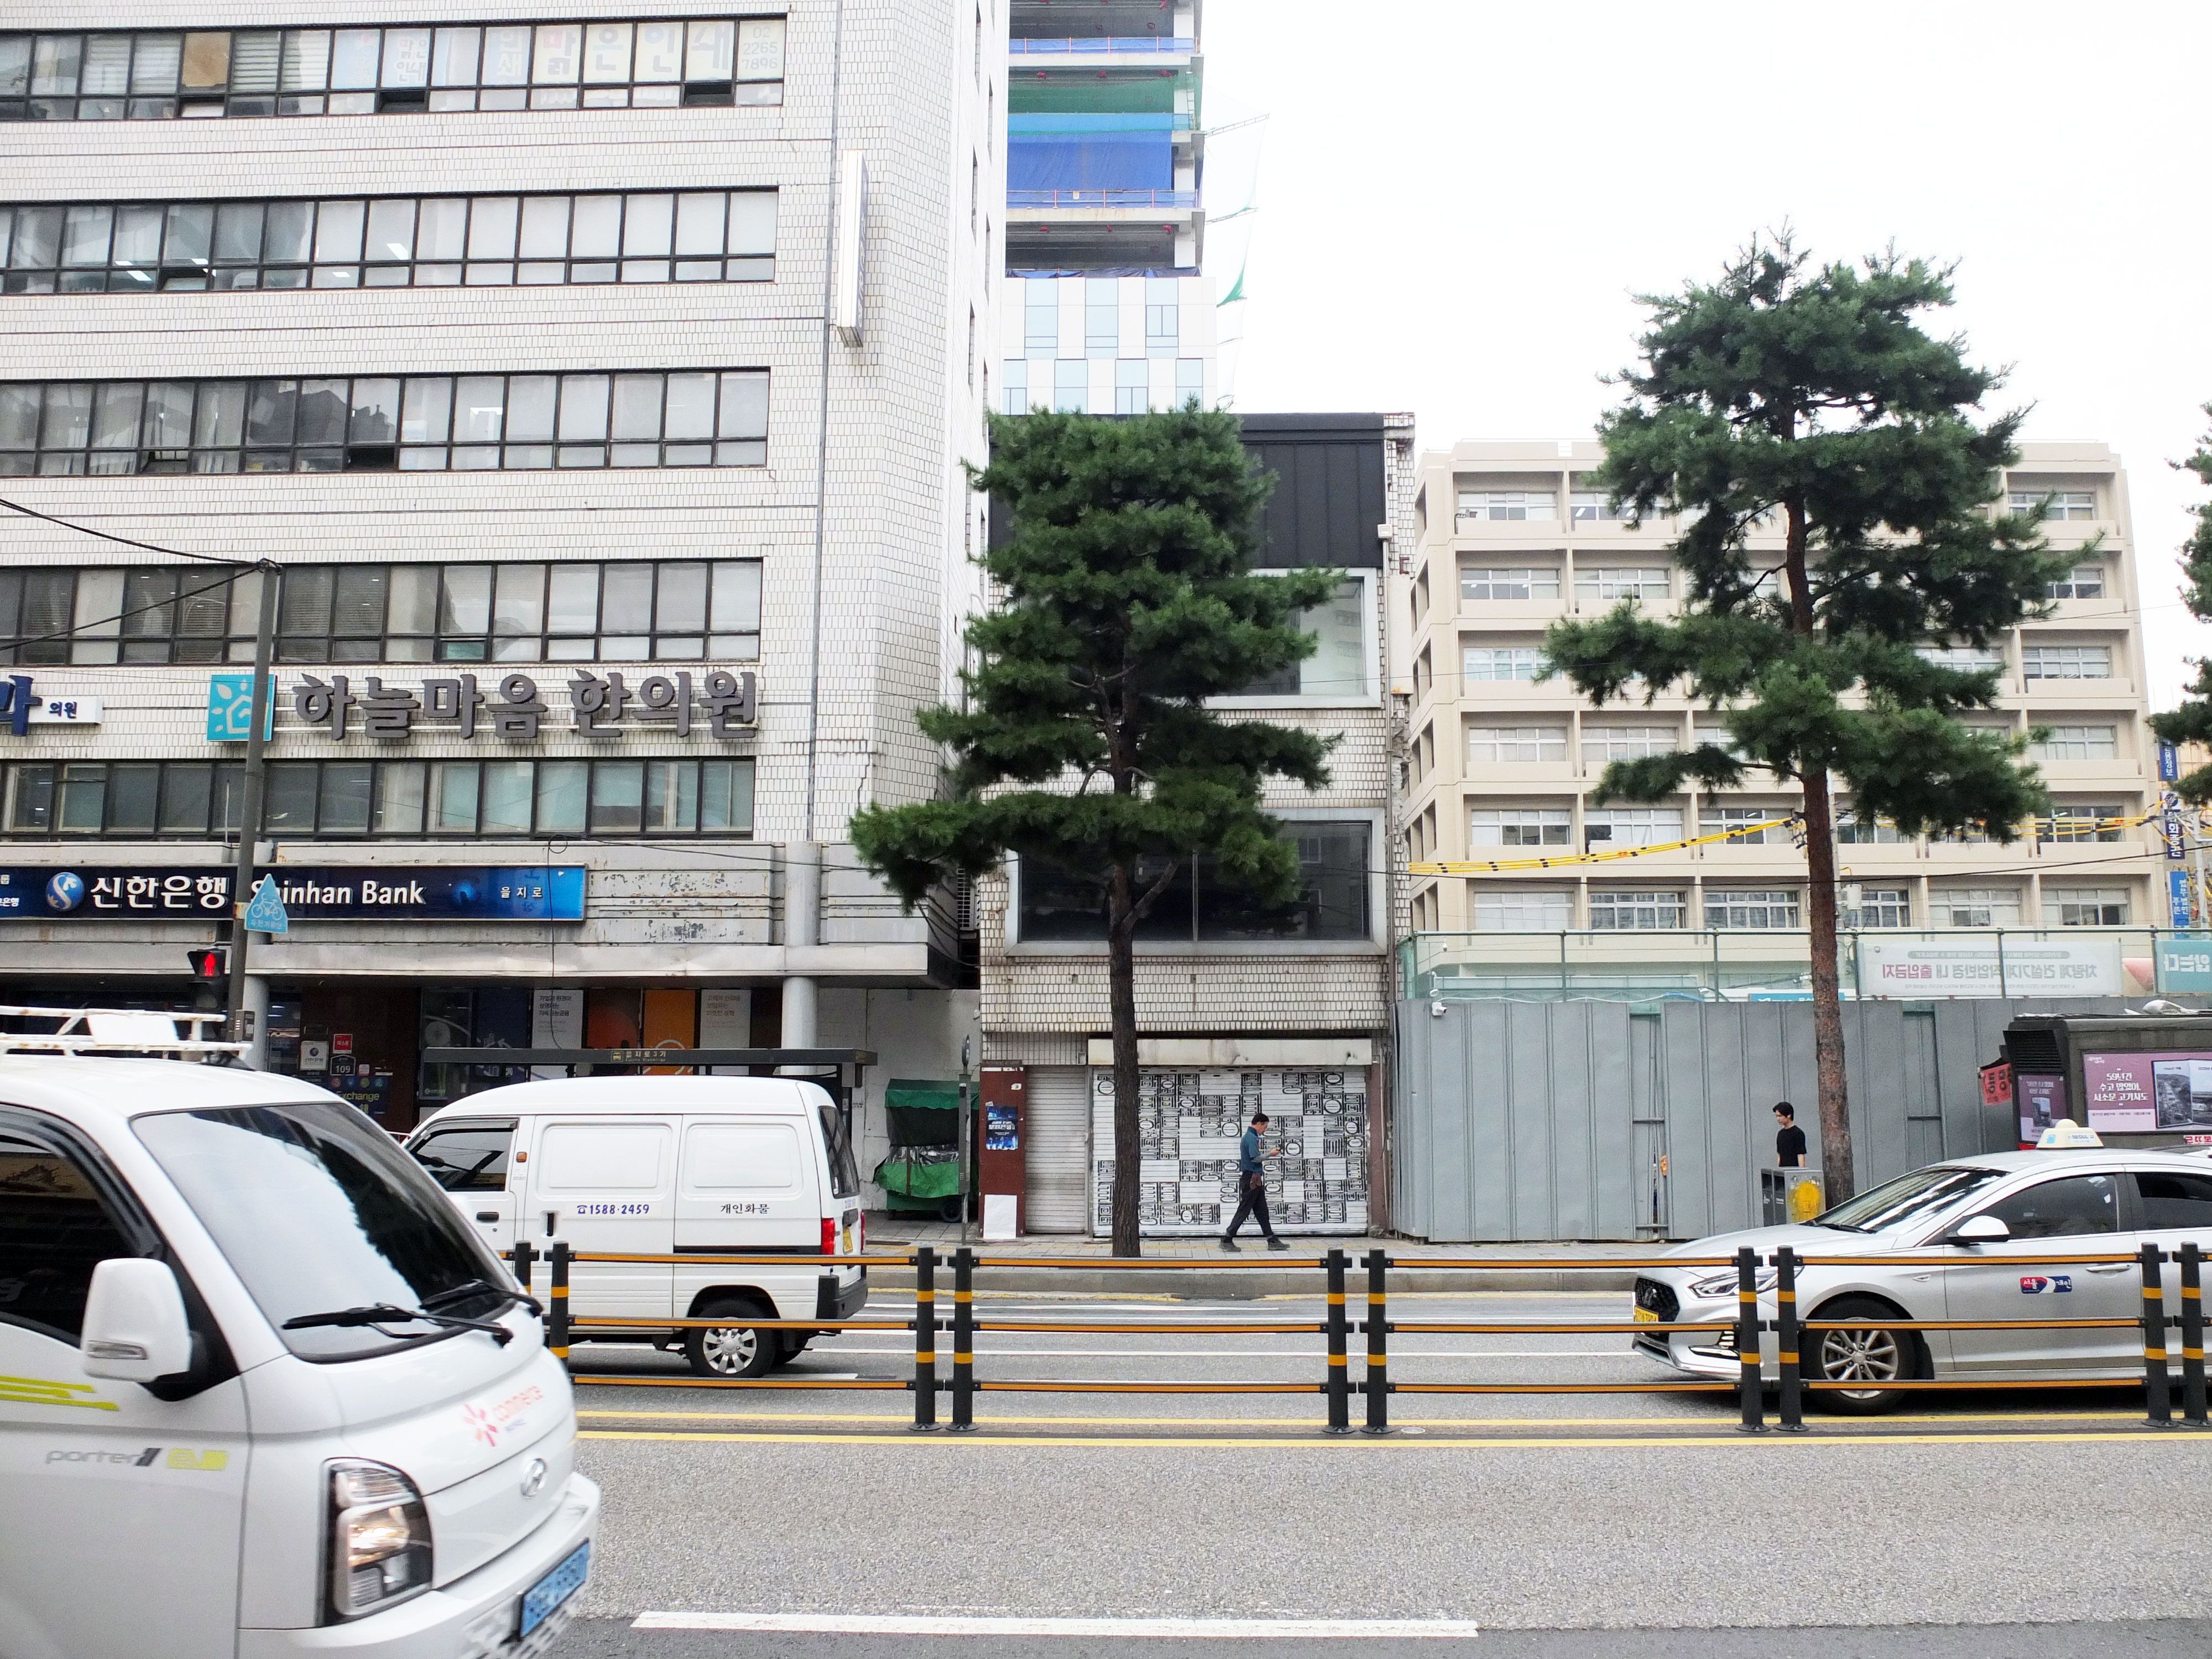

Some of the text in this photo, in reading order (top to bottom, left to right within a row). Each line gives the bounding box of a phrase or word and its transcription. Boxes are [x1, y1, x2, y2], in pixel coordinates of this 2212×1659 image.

[754, 27, 770, 38] 02
[743, 41, 778, 54] 2265
[742, 58, 778, 71] 7896
[48, 701, 77, 719] 의원
[291, 668, 758, 740] 하늘마음 한의원
[90, 875, 229, 909] 신한은행
[362, 879, 425, 905] Bank
[500, 885, 543, 899] 을지로
[336, 1065, 351, 1073] 109
[720, 1202, 770, 1215] 개인화물
